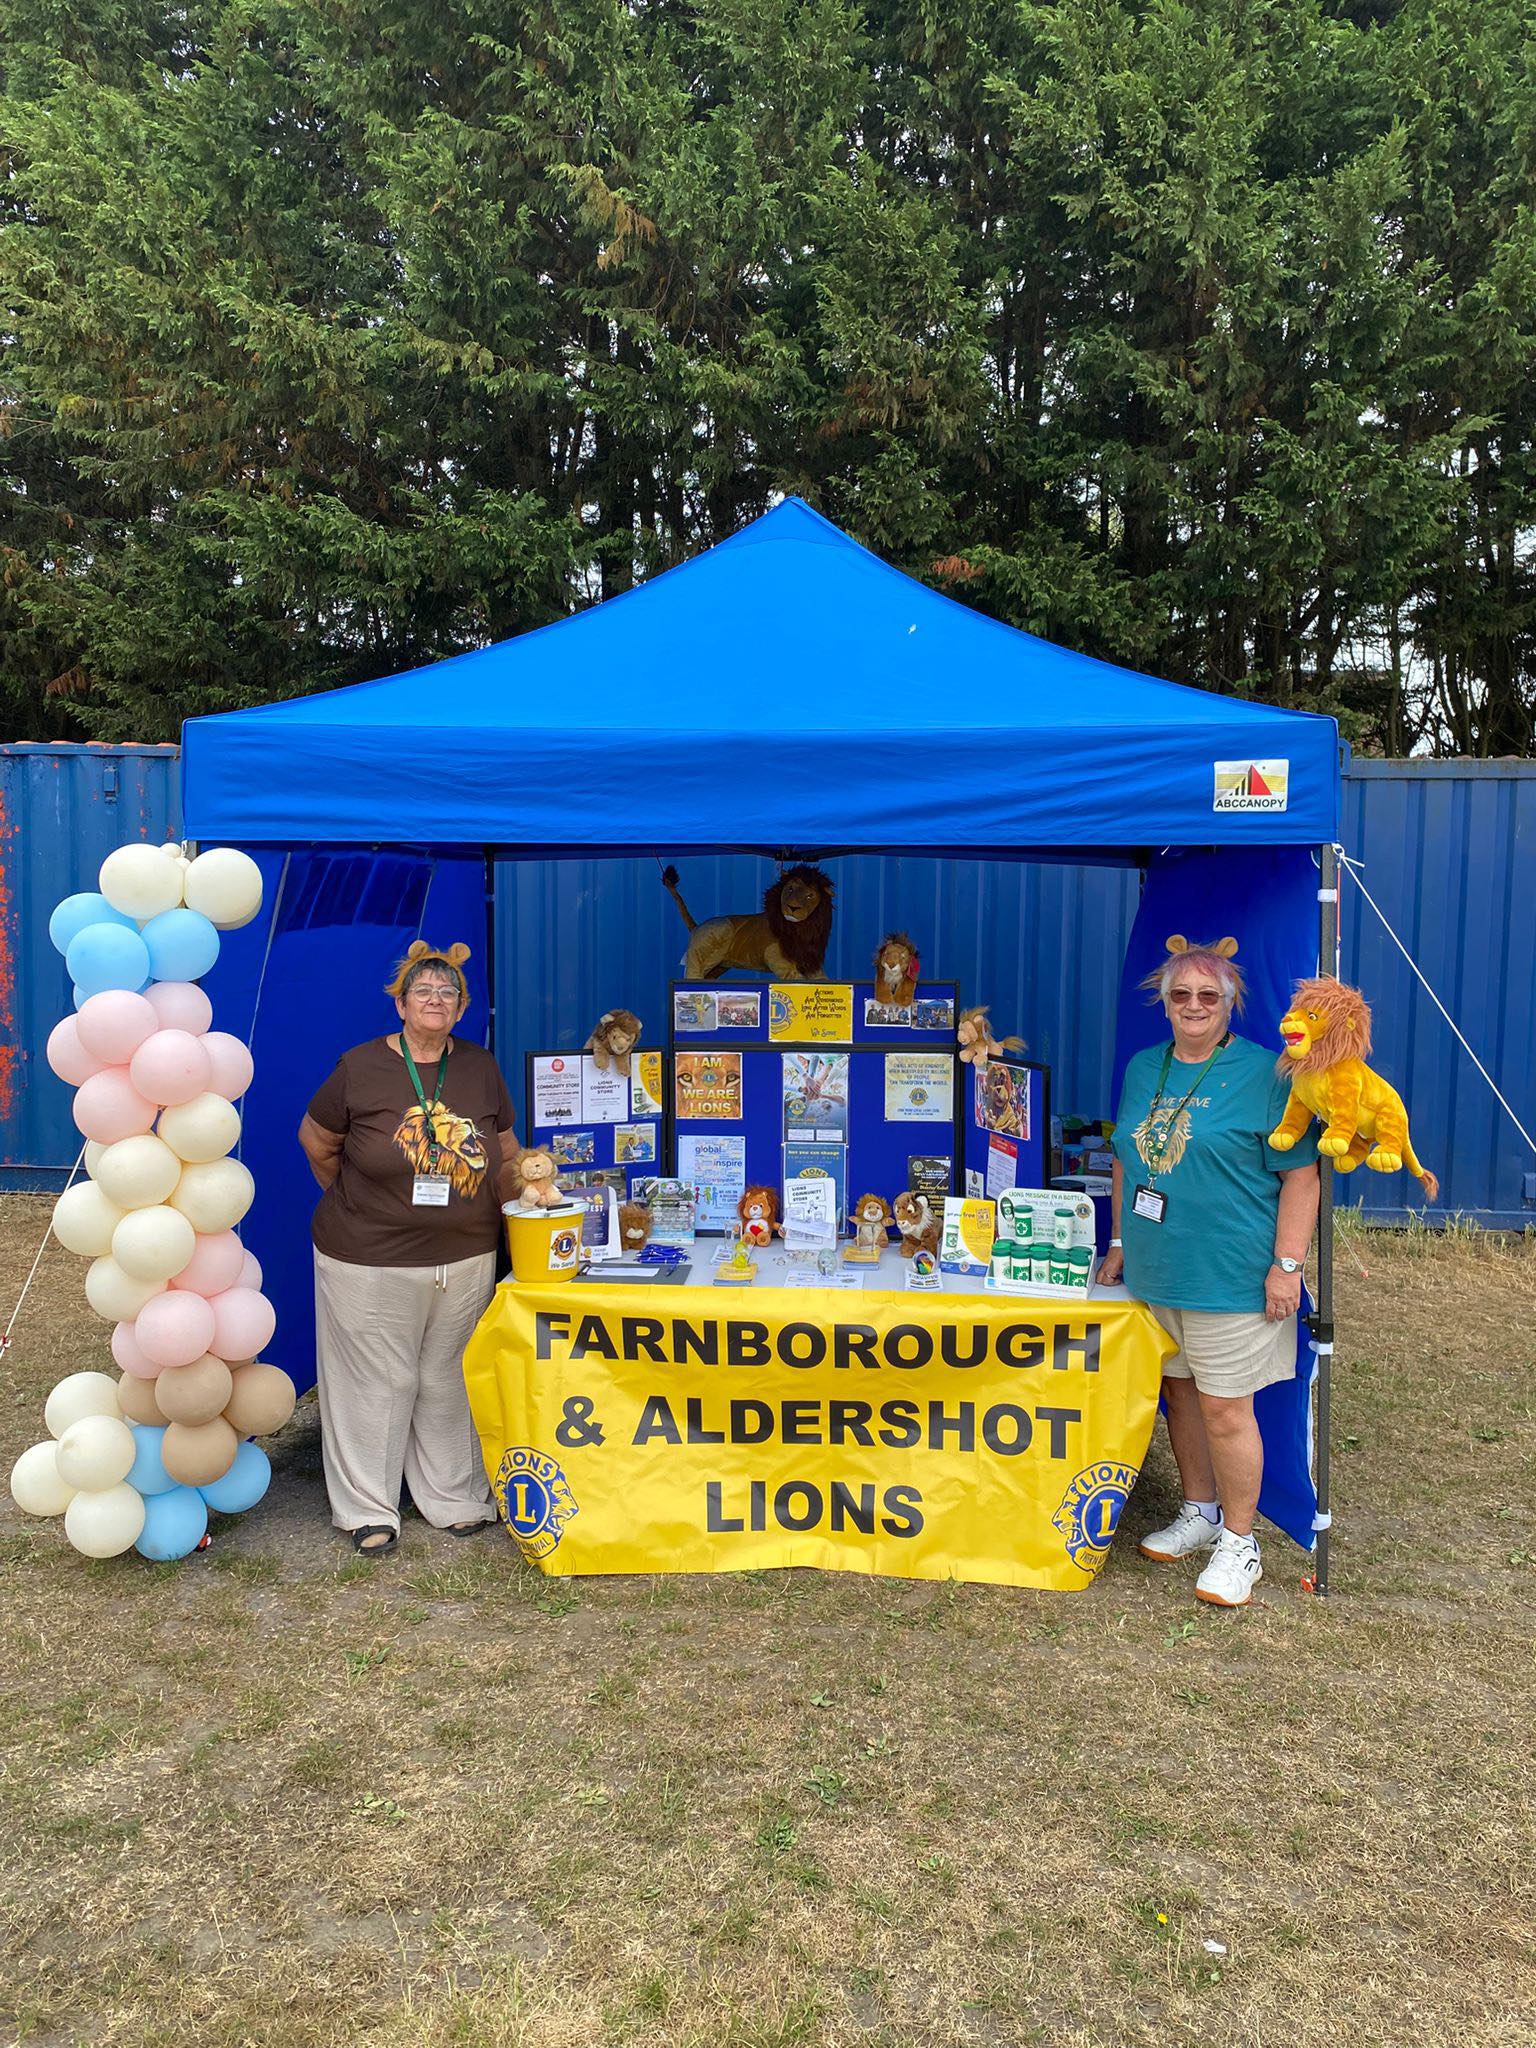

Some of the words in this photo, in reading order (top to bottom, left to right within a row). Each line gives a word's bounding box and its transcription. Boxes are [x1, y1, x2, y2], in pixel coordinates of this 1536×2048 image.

[1215, 799, 1285, 808] ABCCANOPY
[694, 1057, 698, 1067] I
[701, 1057, 726, 1067] AM.
[683, 1088, 705, 1099] WE
[706, 1088, 738, 1099] ARE.
[690, 1102, 732, 1113] LIONS
[695, 1146, 722, 1154] global
[713, 1160, 743, 1168] inspire
[801, 1168, 827, 1178] LIONS
[792, 1189, 822, 1197] COMMUNITY
[1063, 1194, 1085, 1202] BOTTLE
[588, 1205, 604, 1213] EST
[535, 1311, 1102, 1373] FARNBOROUGH
[555, 1395, 607, 1448] &
[631, 1395, 1082, 1460] ALDERSHOT
[507, 1451, 554, 1478] IONS
[1079, 1465, 1138, 1492] LIONS
[513, 1483, 537, 1524] L
[706, 1480, 925, 1539] LIONS
[1096, 1499, 1116, 1538] L
